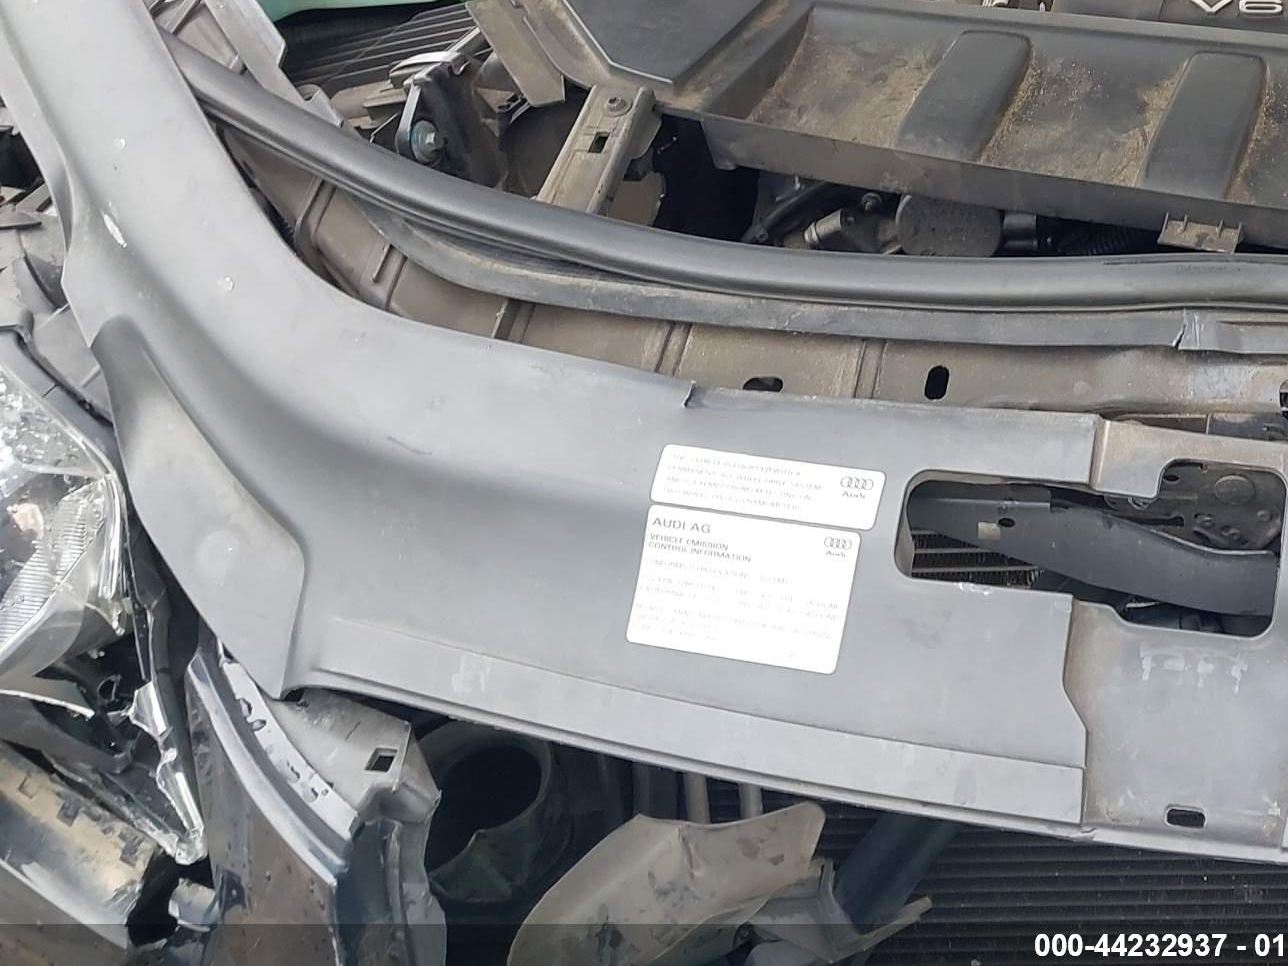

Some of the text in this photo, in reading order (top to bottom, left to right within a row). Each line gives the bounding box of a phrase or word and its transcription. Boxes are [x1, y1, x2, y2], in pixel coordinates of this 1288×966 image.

[652, 517, 711, 534] AUDI AG
[650, 533, 729, 551] VEHICLE EMISSION
[648, 541, 752, 562] CONTROL INFORMATION
